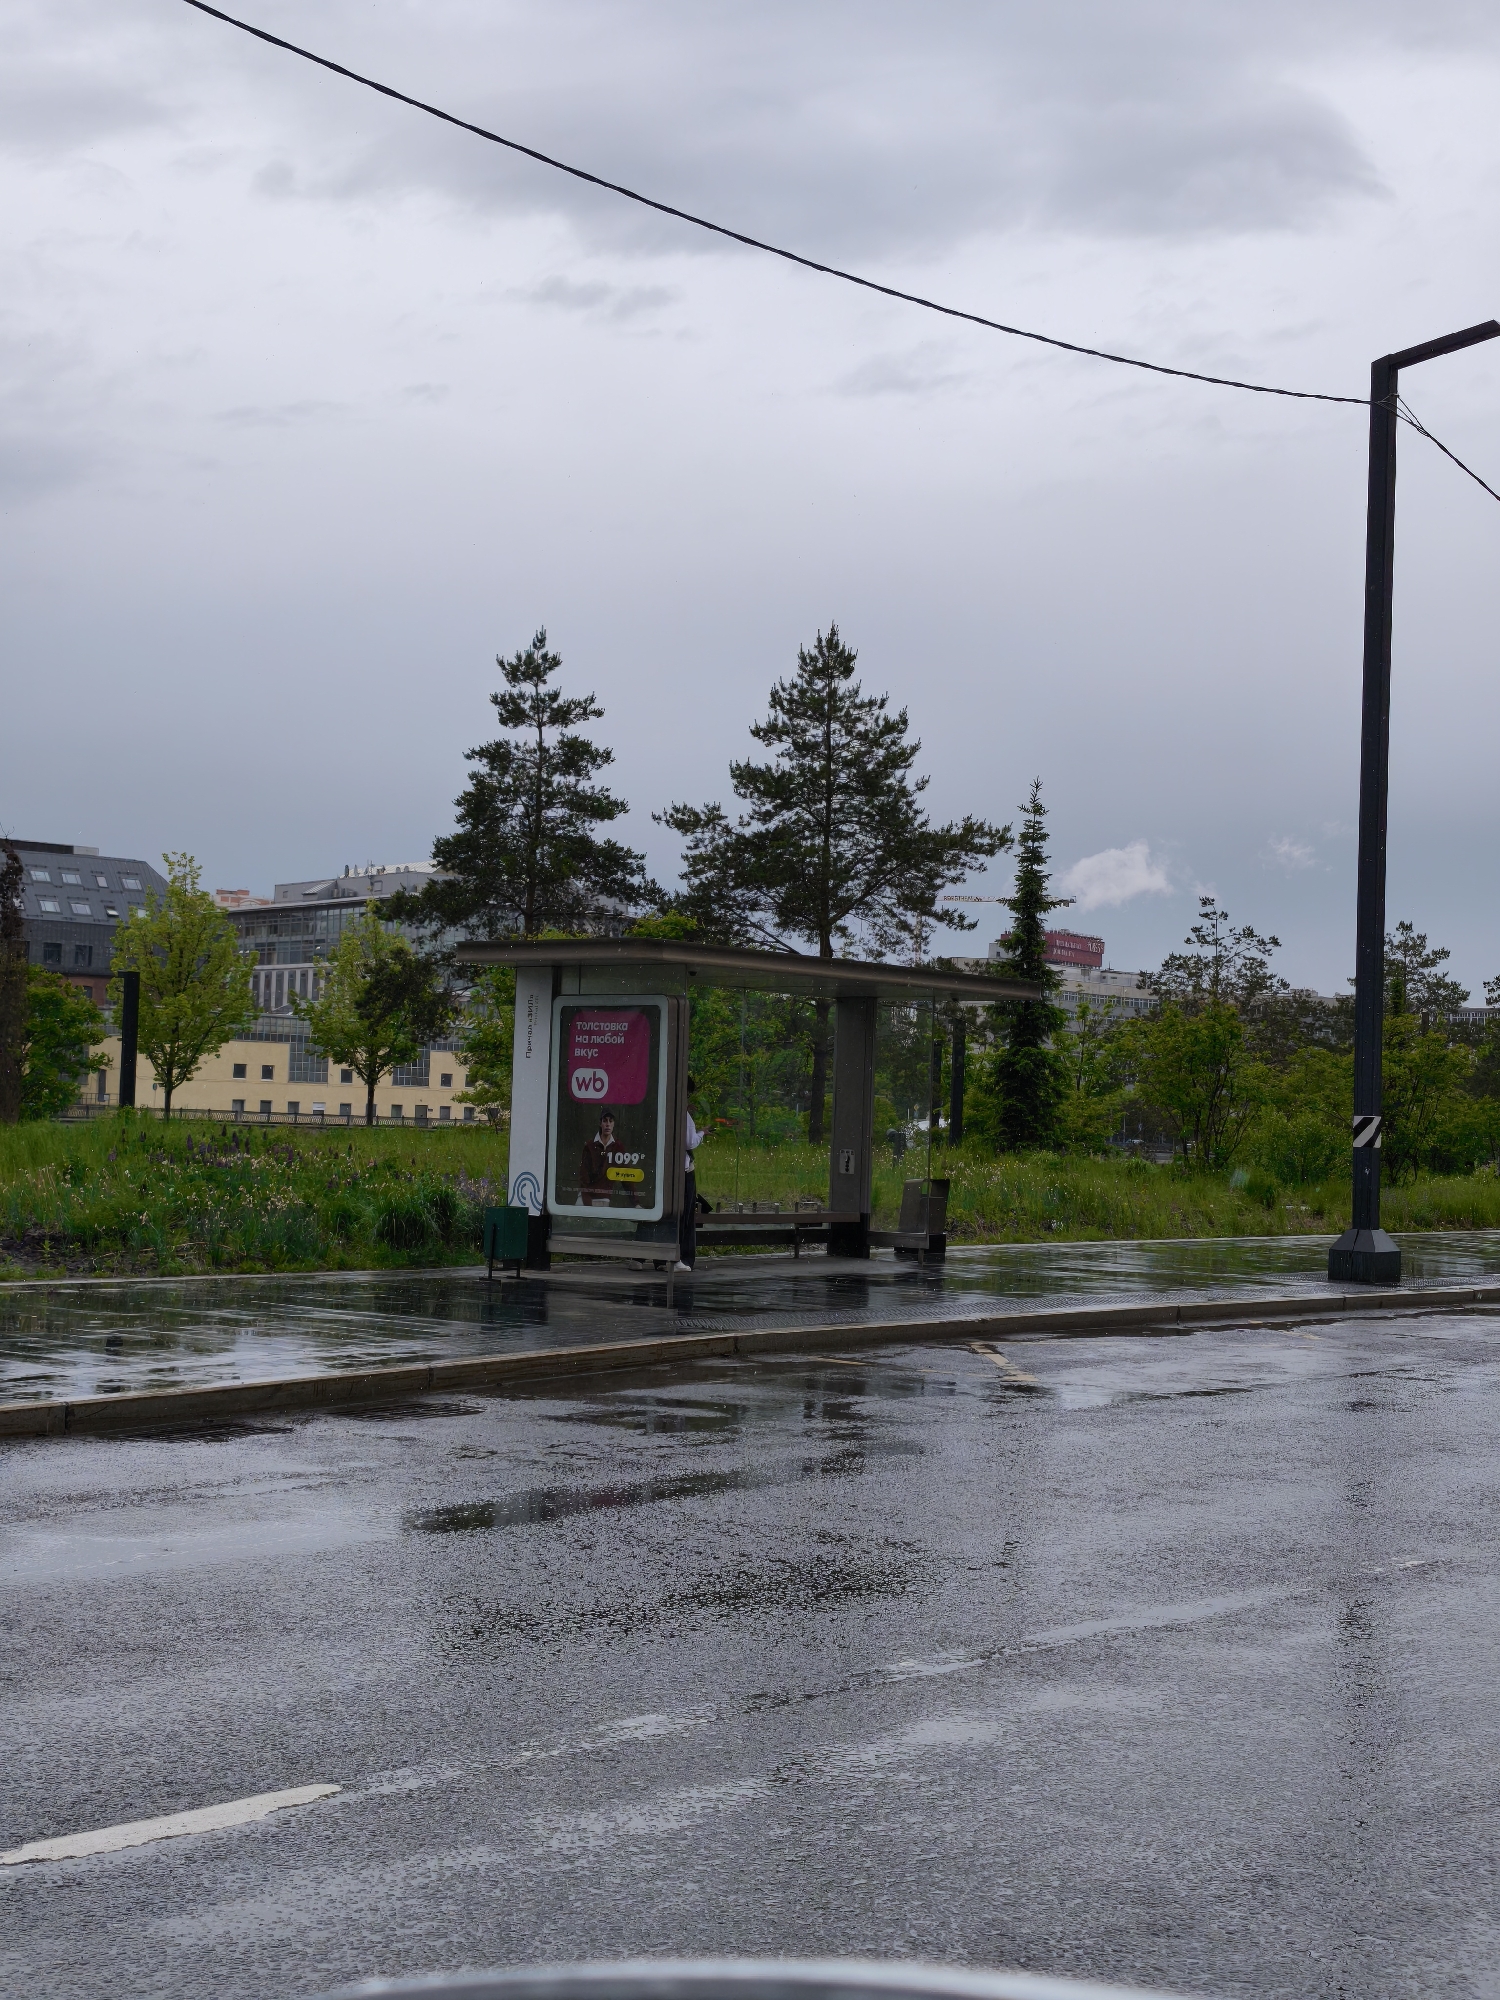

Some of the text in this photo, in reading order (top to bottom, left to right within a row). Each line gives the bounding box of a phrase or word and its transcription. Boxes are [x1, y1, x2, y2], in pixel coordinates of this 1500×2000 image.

[575, 1021, 629, 1031] толстовка
[525, 1024, 533, 1059] Причал
[575, 1033, 625, 1044] на любой
[574, 1048, 599, 1059] вкус
[575, 1071, 605, 1092] wb
